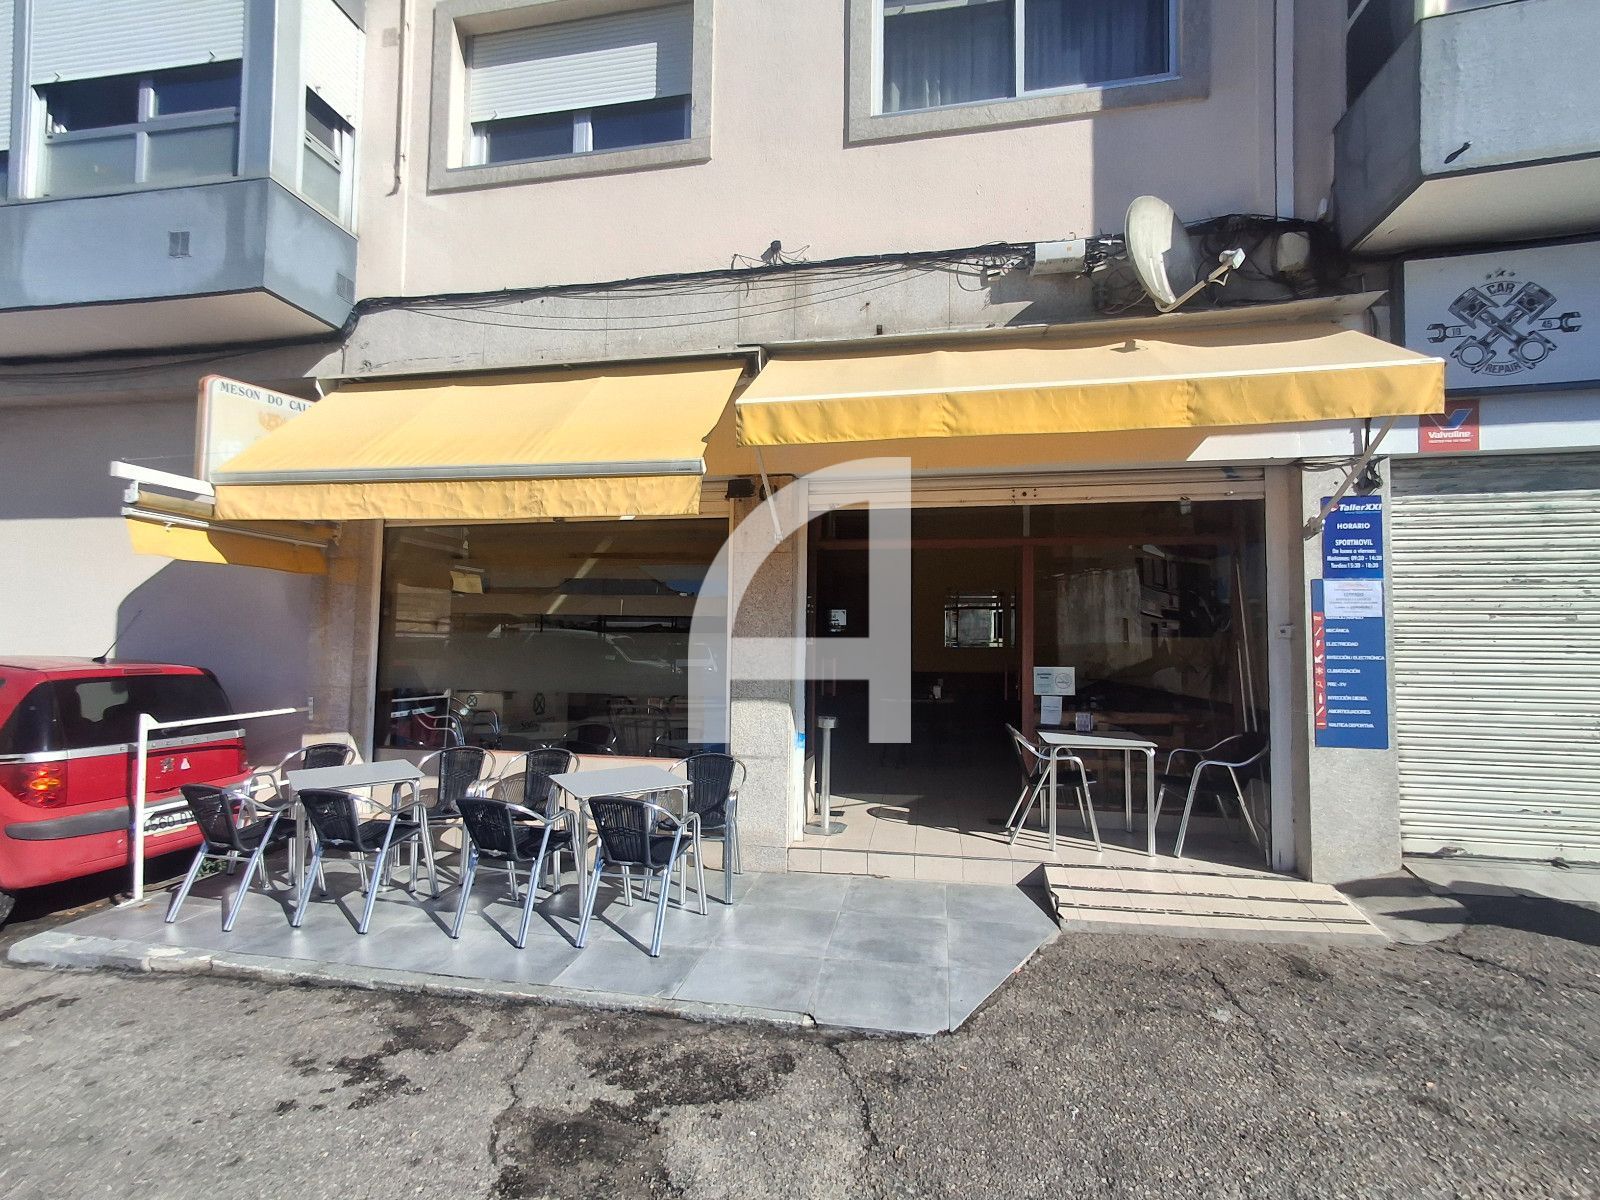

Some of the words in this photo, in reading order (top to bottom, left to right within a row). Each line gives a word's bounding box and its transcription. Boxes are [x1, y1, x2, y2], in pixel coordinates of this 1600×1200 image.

[1486, 282, 1516, 295] CAR
[1485, 361, 1522, 374] REPAIR
[220, 381, 261, 400] MESON
[267, 394, 283, 406] DO
[1427, 430, 1471, 438] Valvoline
[1337, 522, 1371, 530] HORARIO
